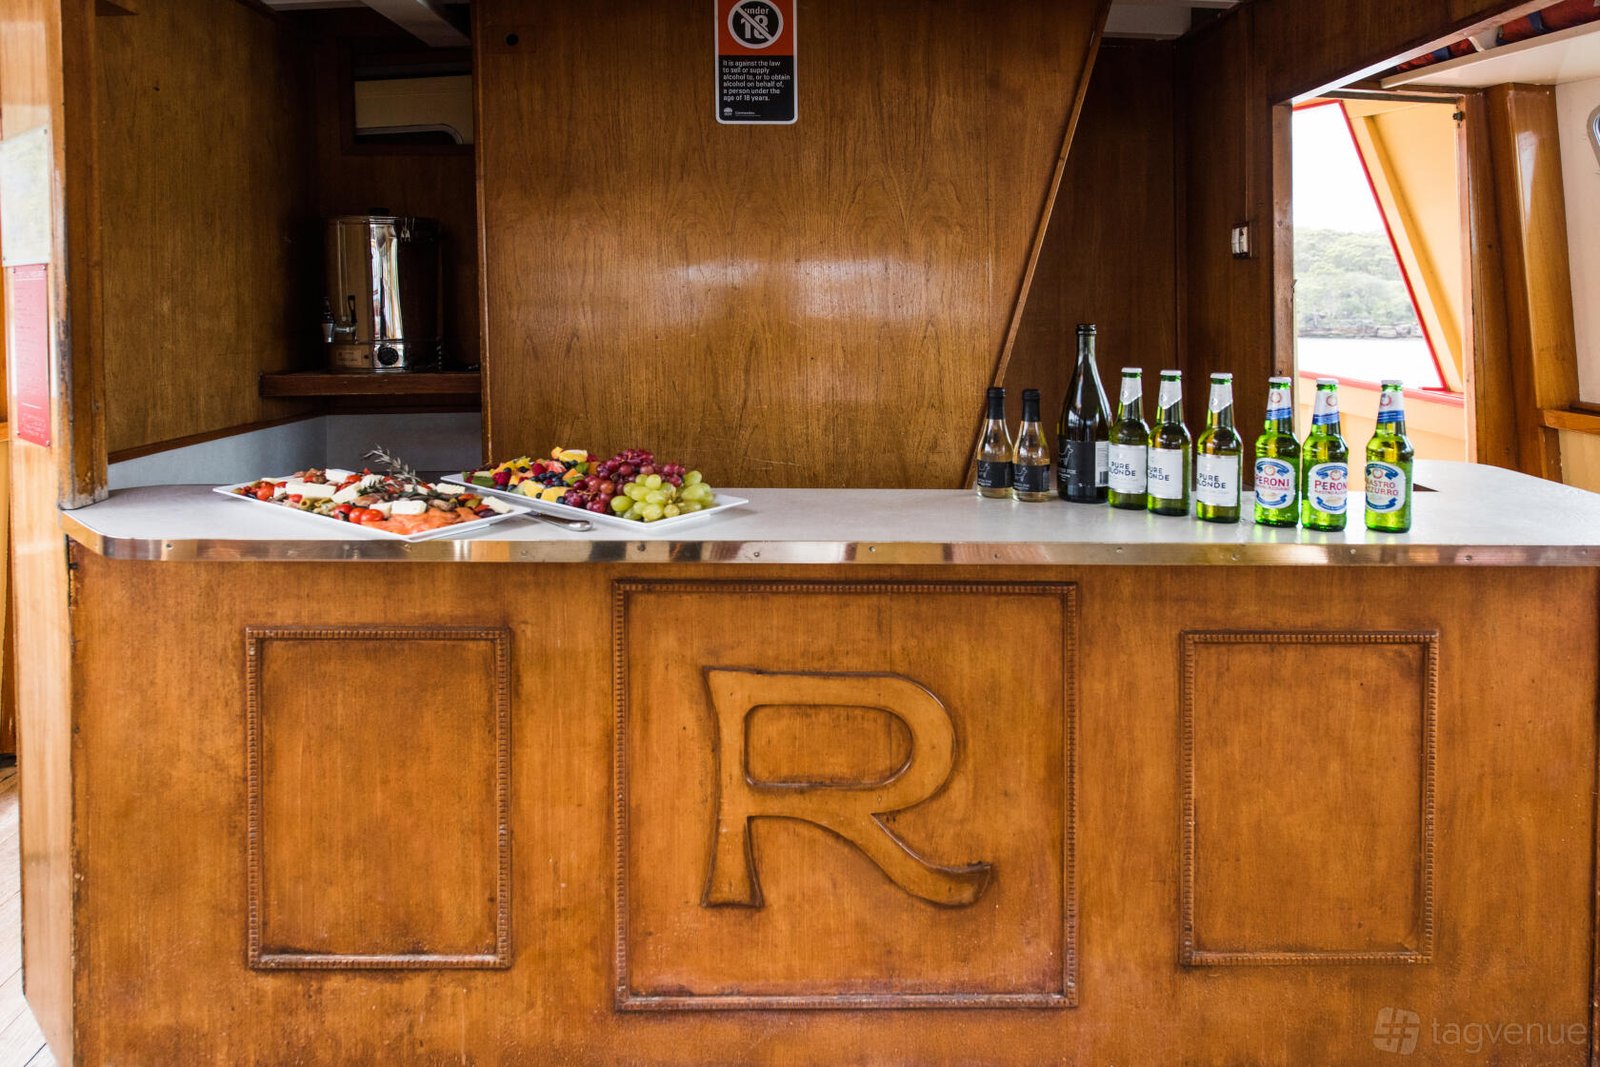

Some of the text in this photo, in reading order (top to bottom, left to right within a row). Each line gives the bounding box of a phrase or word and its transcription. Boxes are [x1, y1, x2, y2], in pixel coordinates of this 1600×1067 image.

[740, 15, 769, 39] 18
[735, 60, 757, 68] against
[749, 67, 770, 75] supply
[1111, 461, 1130, 470] PURE
[1199, 472, 1220, 482] PURE
[1255, 473, 1290, 487] PERONI
[1314, 479, 1347, 491] PERON
[701, 665, 994, 909] R
